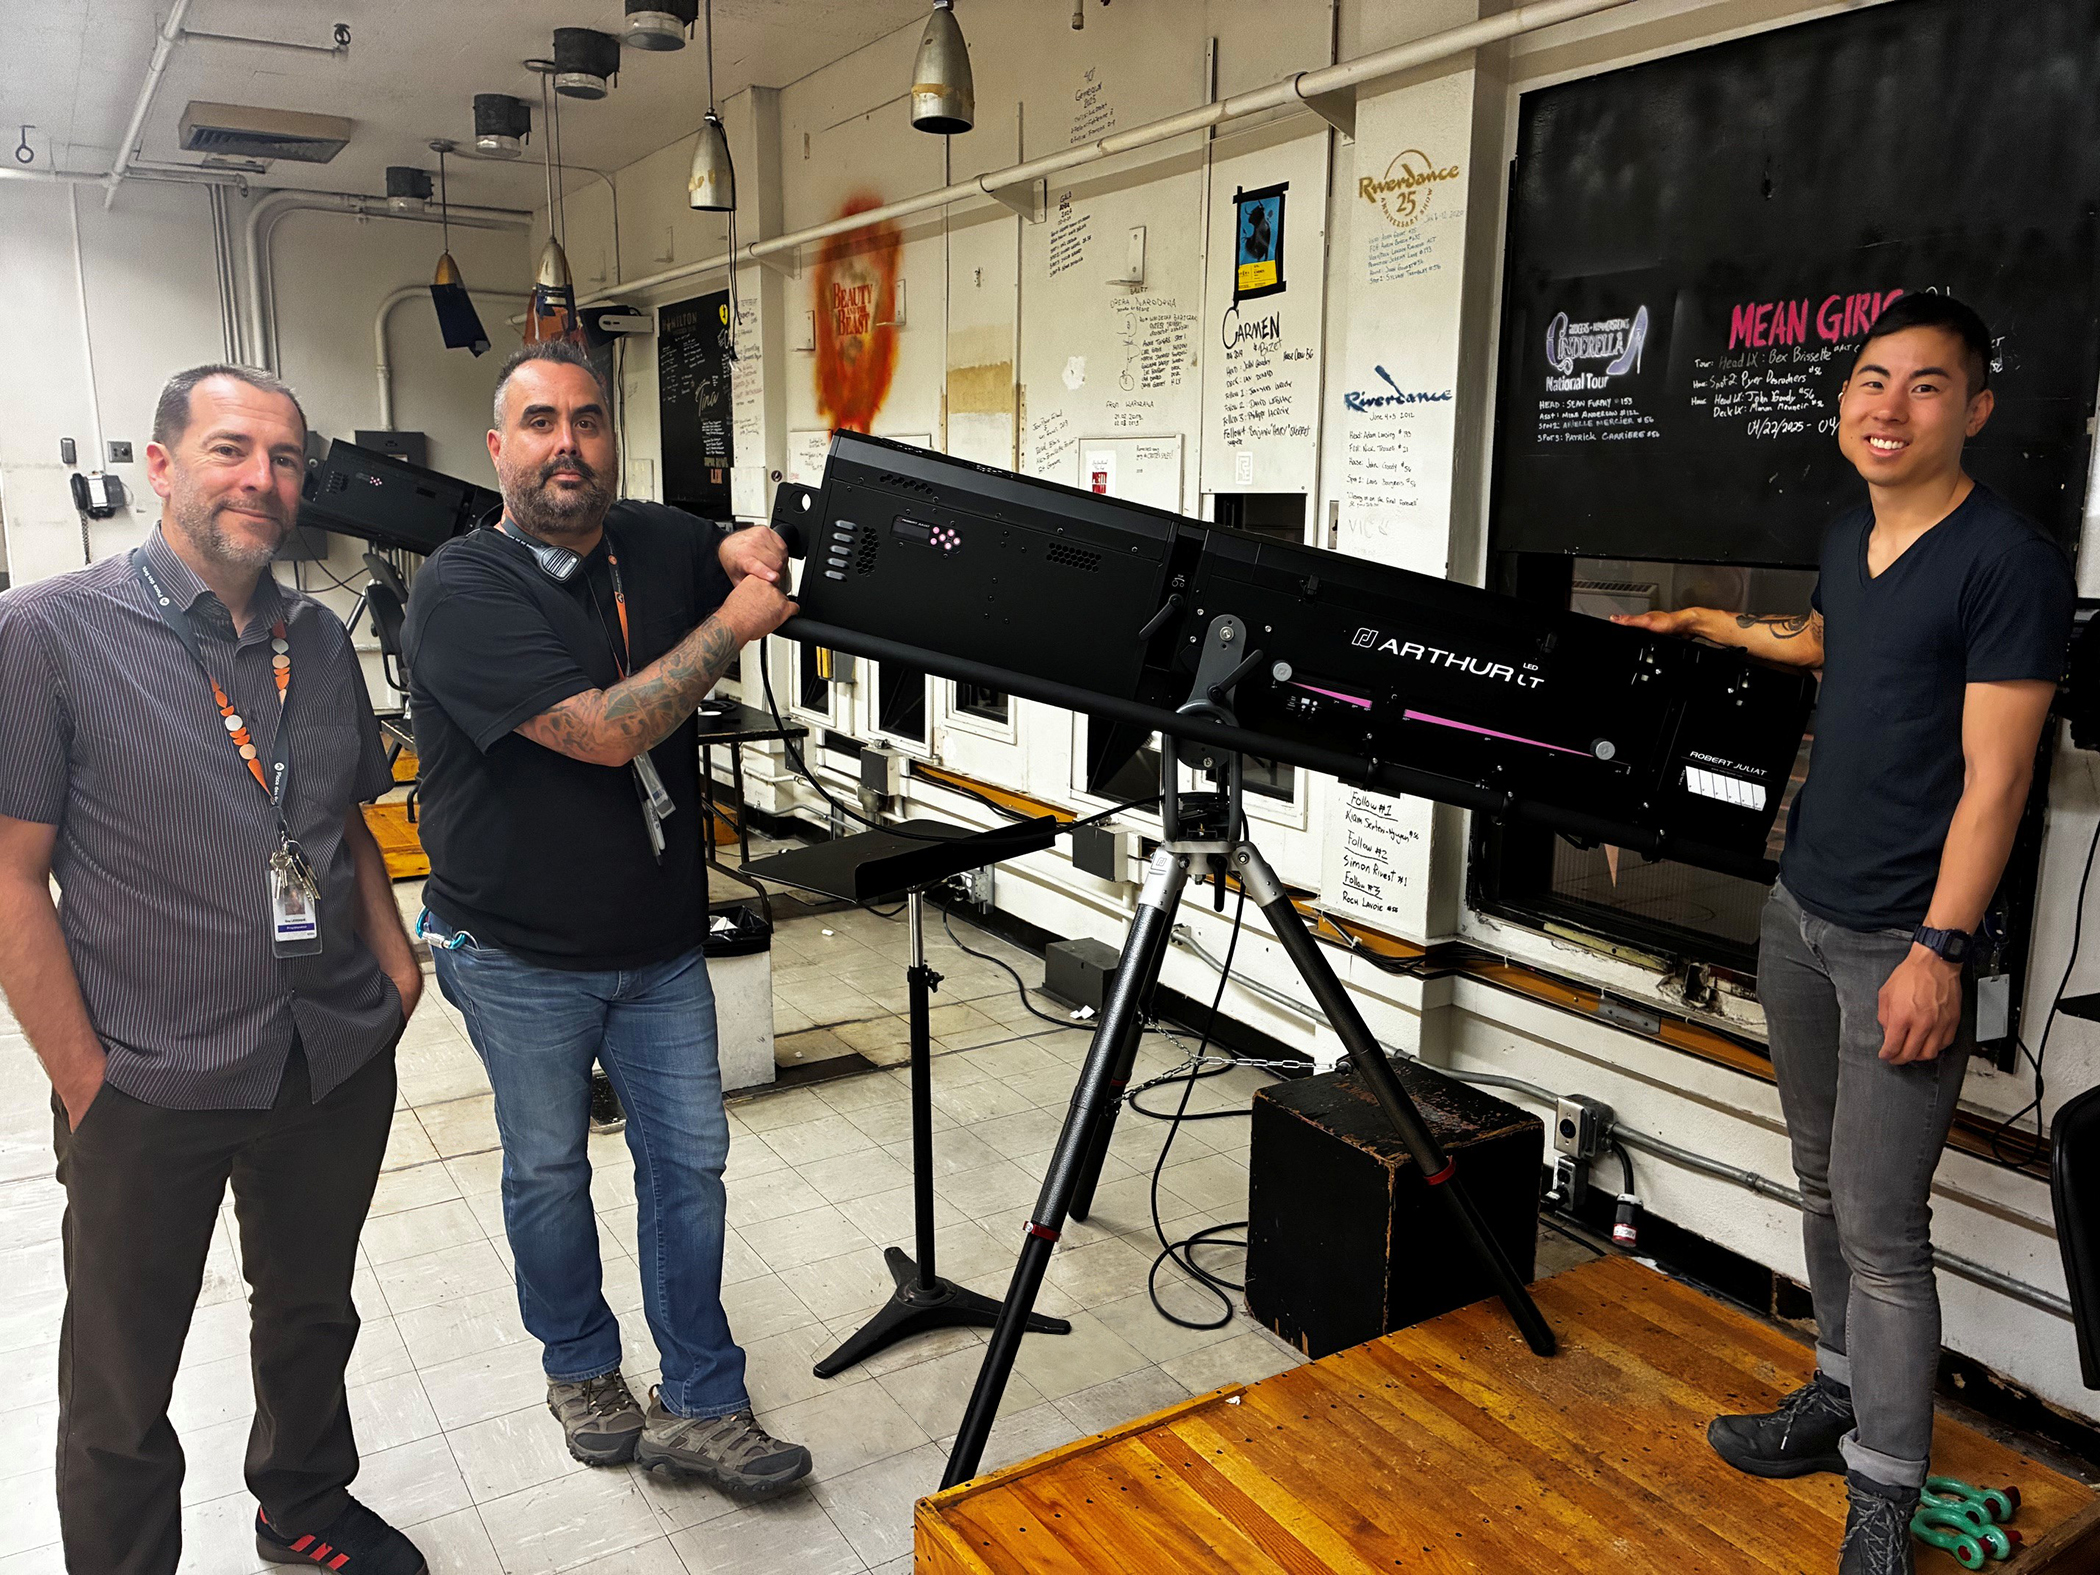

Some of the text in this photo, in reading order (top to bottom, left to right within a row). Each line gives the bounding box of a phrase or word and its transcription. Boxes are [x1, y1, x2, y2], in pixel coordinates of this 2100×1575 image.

[1359, 163, 1460, 204] Riverdance
[1396, 190, 1417, 217] 25
[833, 282, 873, 310] BEAUTY
[838, 312, 870, 335] BEAST
[1222, 306, 1281, 349] CARMEN
[1728, 298, 1809, 350] MEAN
[1719, 355, 1744, 370] Head
[1768, 348, 1787, 364] Bex
[1344, 365, 1453, 413] Riverdance
[1546, 372, 1609, 392] National Tour
[1566, 399, 1586, 409] SEAN
[1377, 638, 1545, 689] ARTHUR LT
[1522, 662, 1539, 671] LED
[1689, 750, 1733, 767] ROBERT
[1733, 763, 1768, 776] JULIAT
[1350, 791, 1392, 817] Follow #1
[1347, 829, 1389, 861] Follow #2
[1343, 854, 1371, 873] Simon
[1372, 862, 1397, 883] Rivest
[1367, 883, 1381, 896] #3
